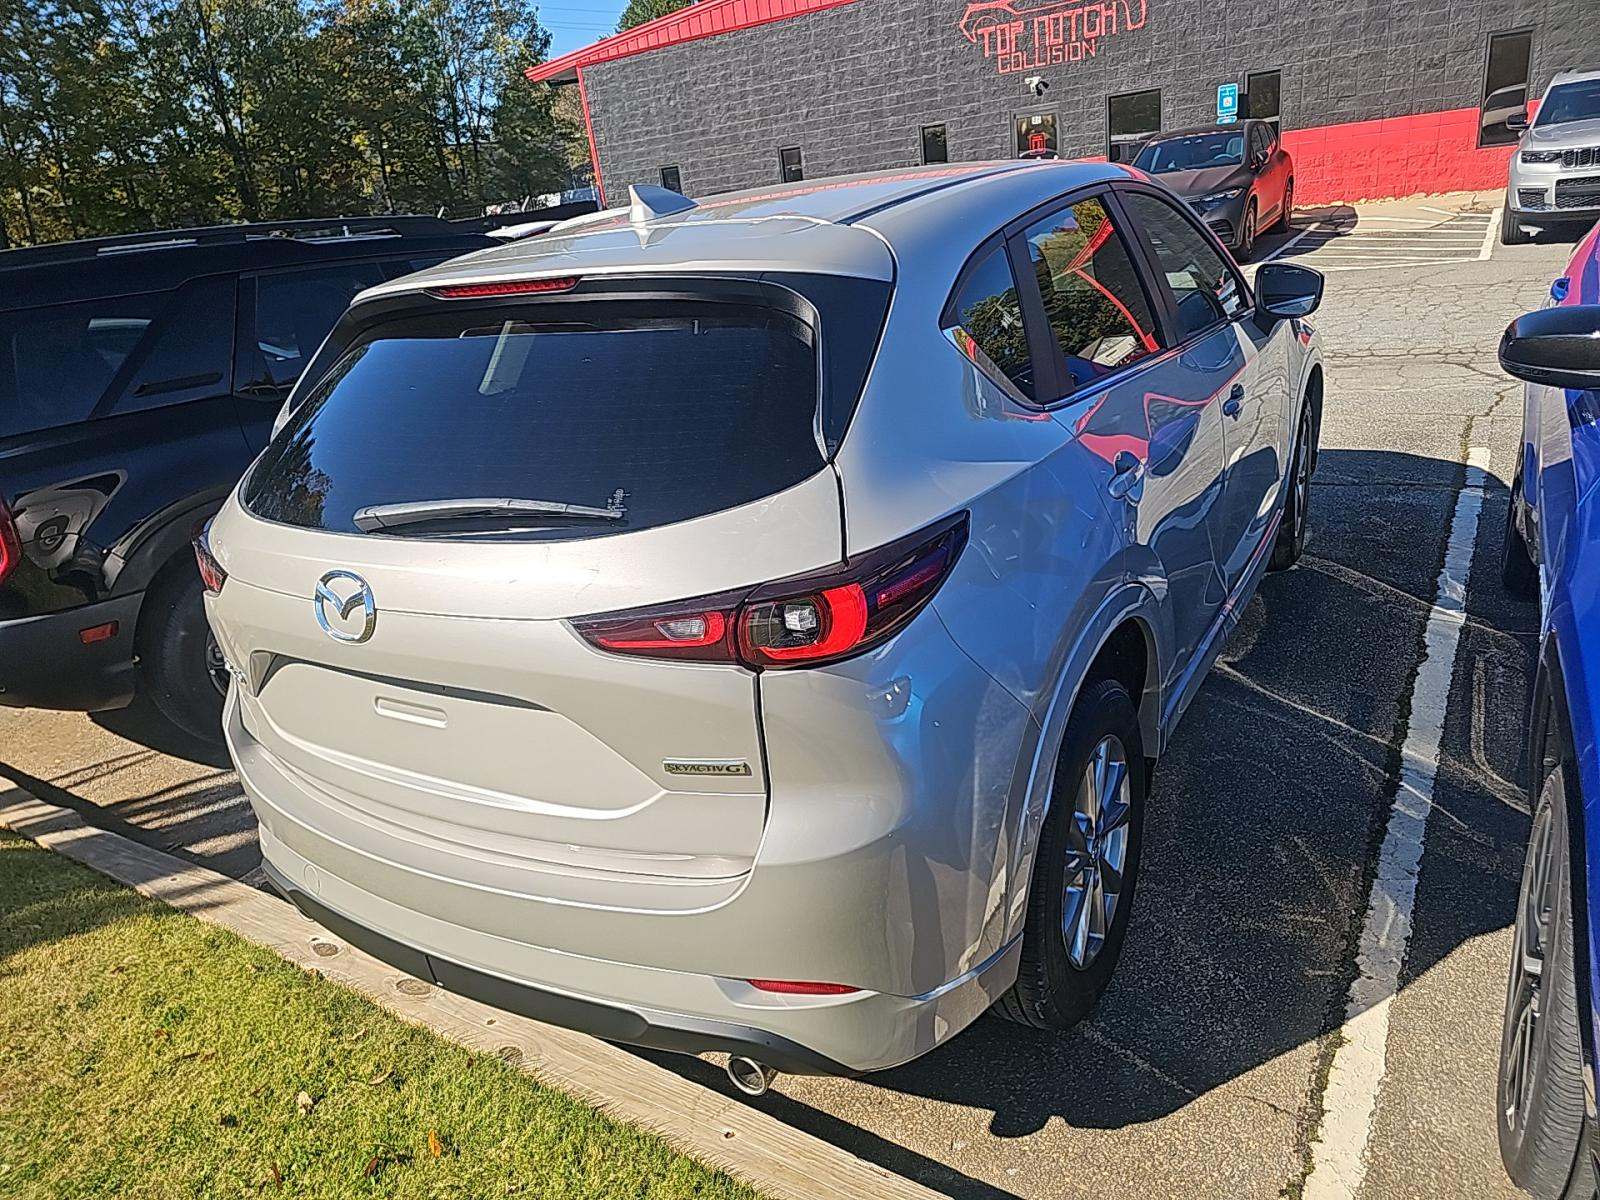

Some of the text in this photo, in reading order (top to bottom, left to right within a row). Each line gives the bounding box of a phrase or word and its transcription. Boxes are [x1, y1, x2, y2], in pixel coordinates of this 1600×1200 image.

[977, 1, 1117, 58] TOP NOTCH
[998, 39, 1096, 74] COLLISION
